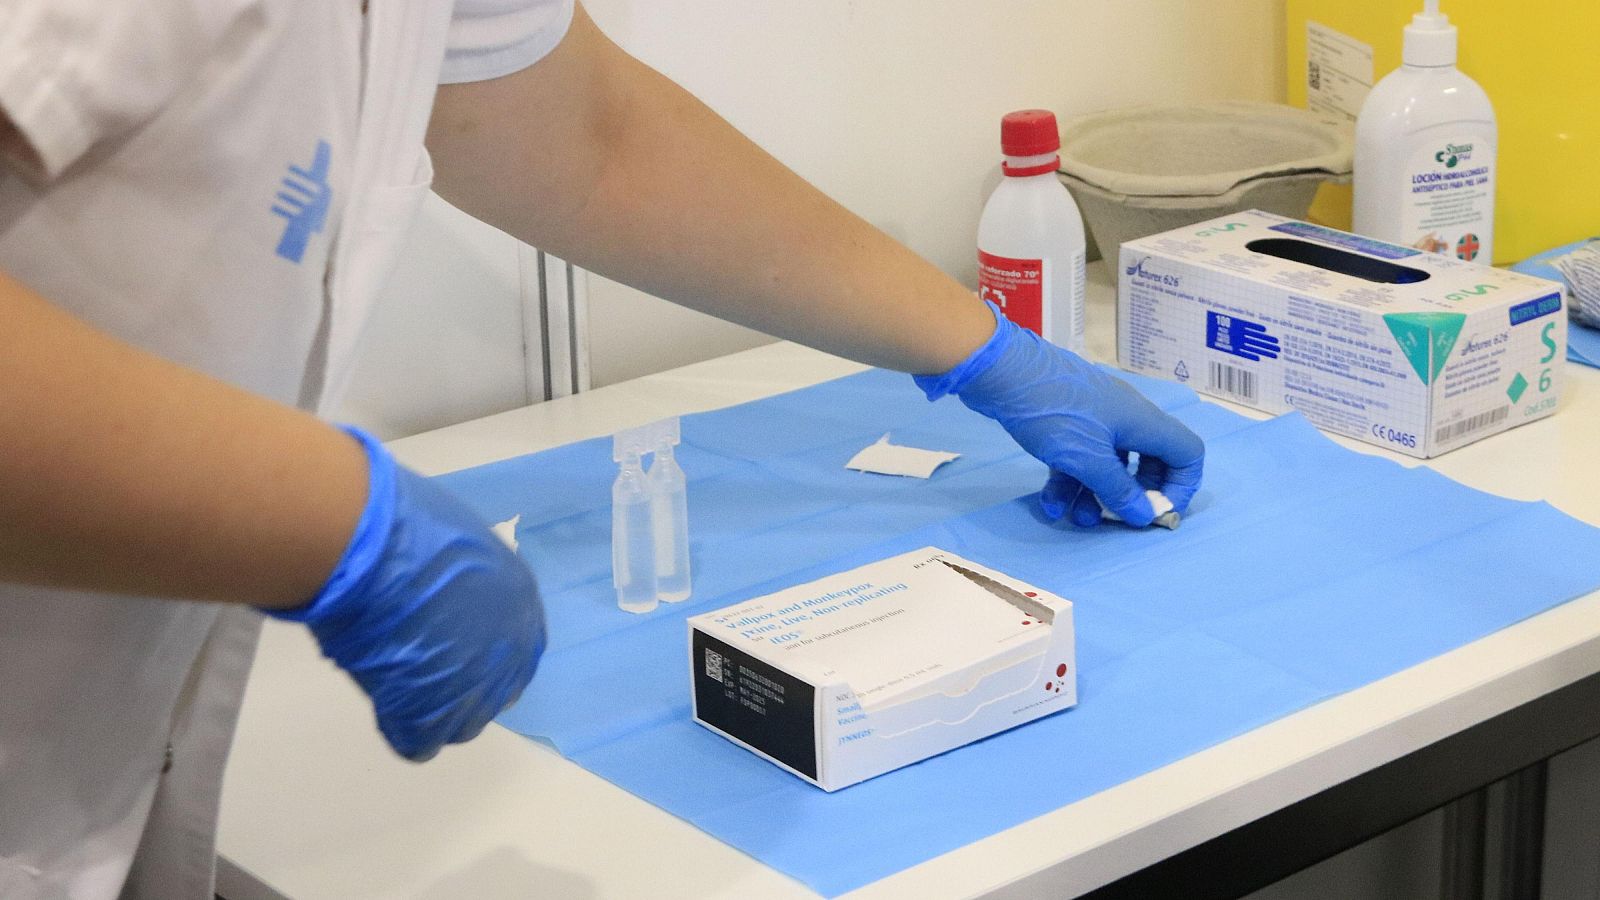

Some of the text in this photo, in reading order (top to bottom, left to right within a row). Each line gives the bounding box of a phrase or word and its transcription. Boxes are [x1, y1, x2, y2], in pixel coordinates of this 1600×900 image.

[1163, 275, 1179, 287] 626
[1216, 314, 1231, 328] 100
[1540, 322, 1556, 364] S
[1538, 368, 1552, 392] 6
[1387, 428, 1417, 448] 0465
[778, 602, 801, 615] and
[802, 582, 873, 607] Monkeypox
[812, 583, 908, 617] Non-replicating
[870, 607, 905, 624] injection
